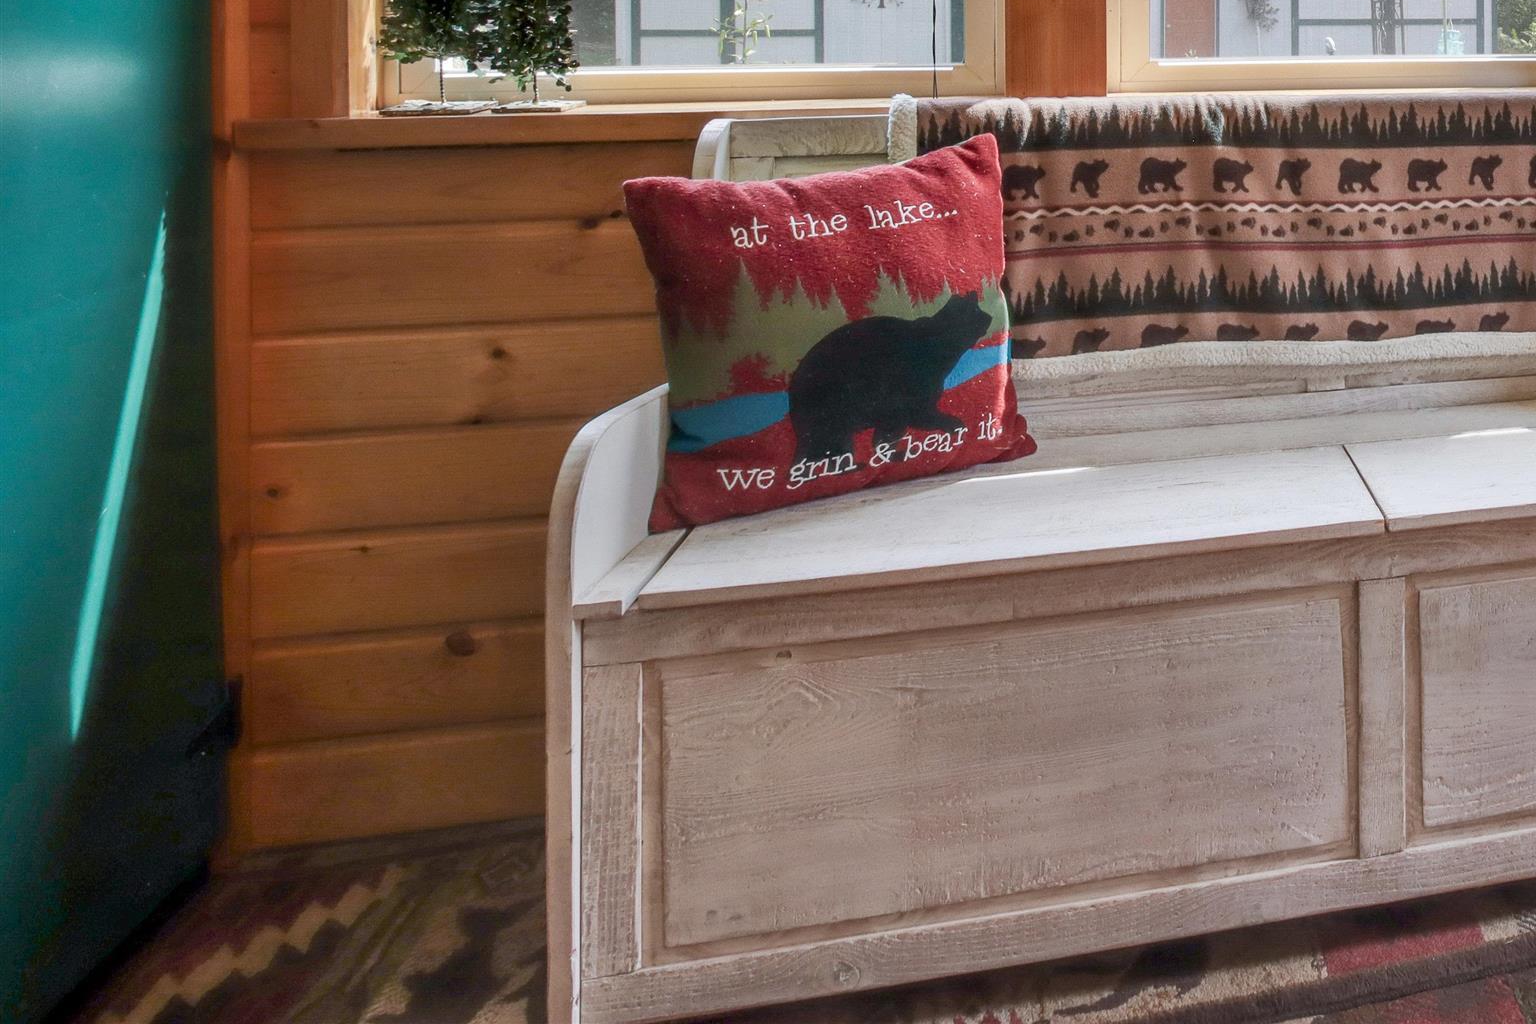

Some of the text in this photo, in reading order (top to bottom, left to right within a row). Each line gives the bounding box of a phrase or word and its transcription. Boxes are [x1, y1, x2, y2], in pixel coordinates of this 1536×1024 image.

[730, 199, 958, 249] at the lake...
[717, 467, 776, 492] we
[786, 450, 857, 490] grin
[869, 442, 897, 468] &
[903, 426, 969, 462] bear
